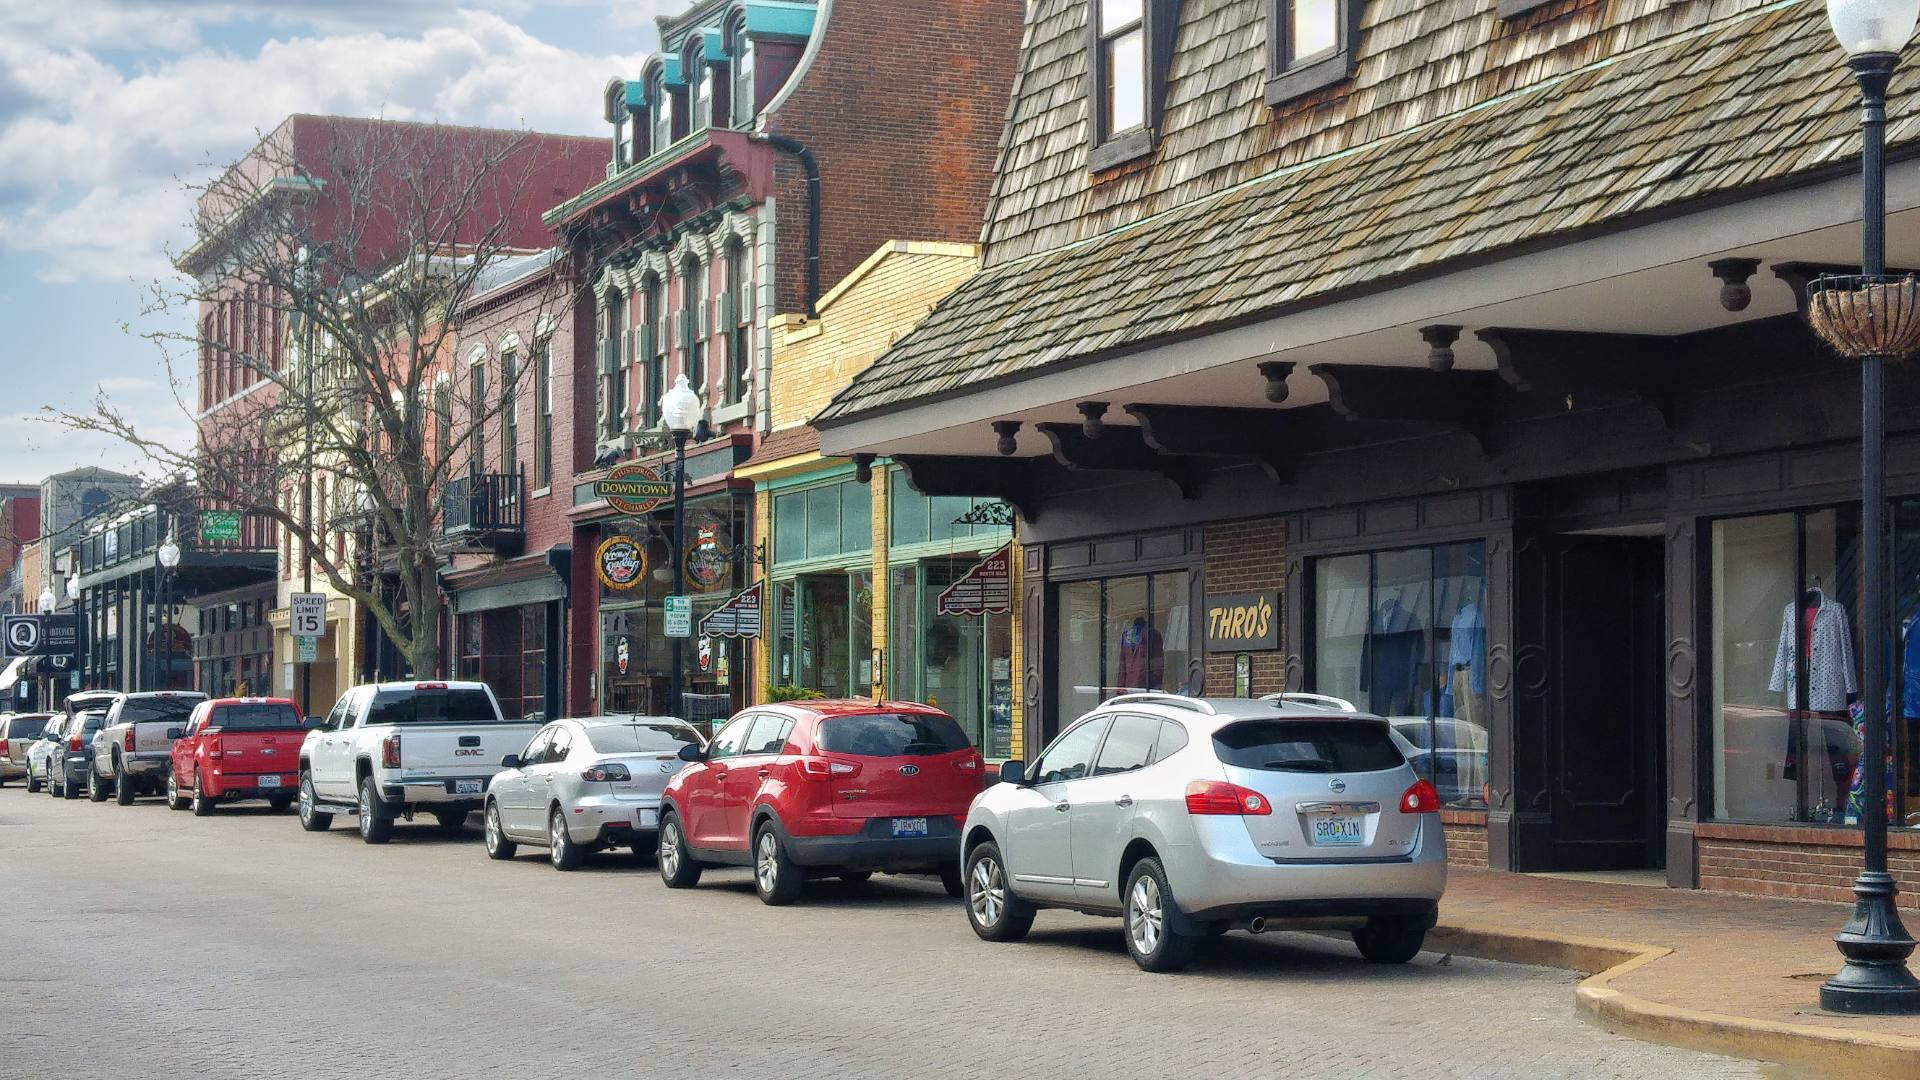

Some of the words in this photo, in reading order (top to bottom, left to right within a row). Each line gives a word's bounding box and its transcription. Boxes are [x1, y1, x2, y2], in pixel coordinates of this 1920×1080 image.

[617, 467, 653, 480] HISTORIC
[601, 482, 668, 495] DOWNTOWN
[987, 561, 1006, 570] 223
[293, 597, 323, 605] SPEED
[666, 599, 673, 610] 2
[741, 595, 756, 604] 223
[297, 606, 319, 614] LIMIT
[298, 615, 318, 631] 15
[1209, 595, 1272, 640] THRO'S
[11, 622, 36, 647] Q
[52, 656, 67, 668] Q
